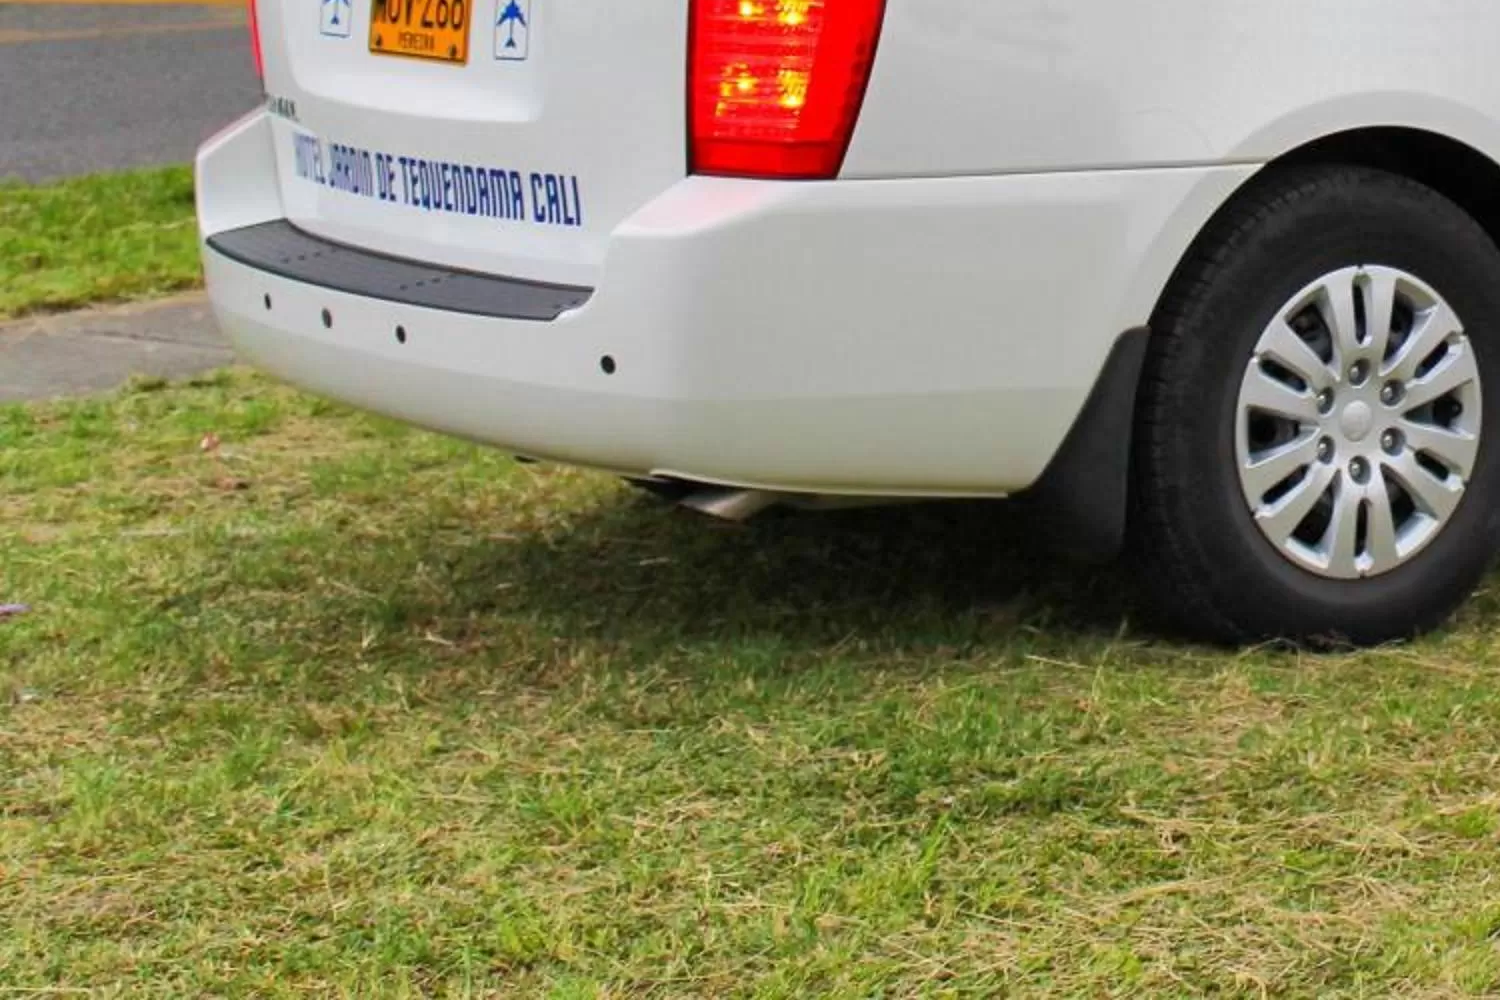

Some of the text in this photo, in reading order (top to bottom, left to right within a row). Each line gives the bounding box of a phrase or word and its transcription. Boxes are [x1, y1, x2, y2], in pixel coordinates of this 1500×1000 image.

[376, 151, 397, 202] DE
[398, 155, 525, 222] TEQUENDAMA
[529, 171, 582, 227] CALI
